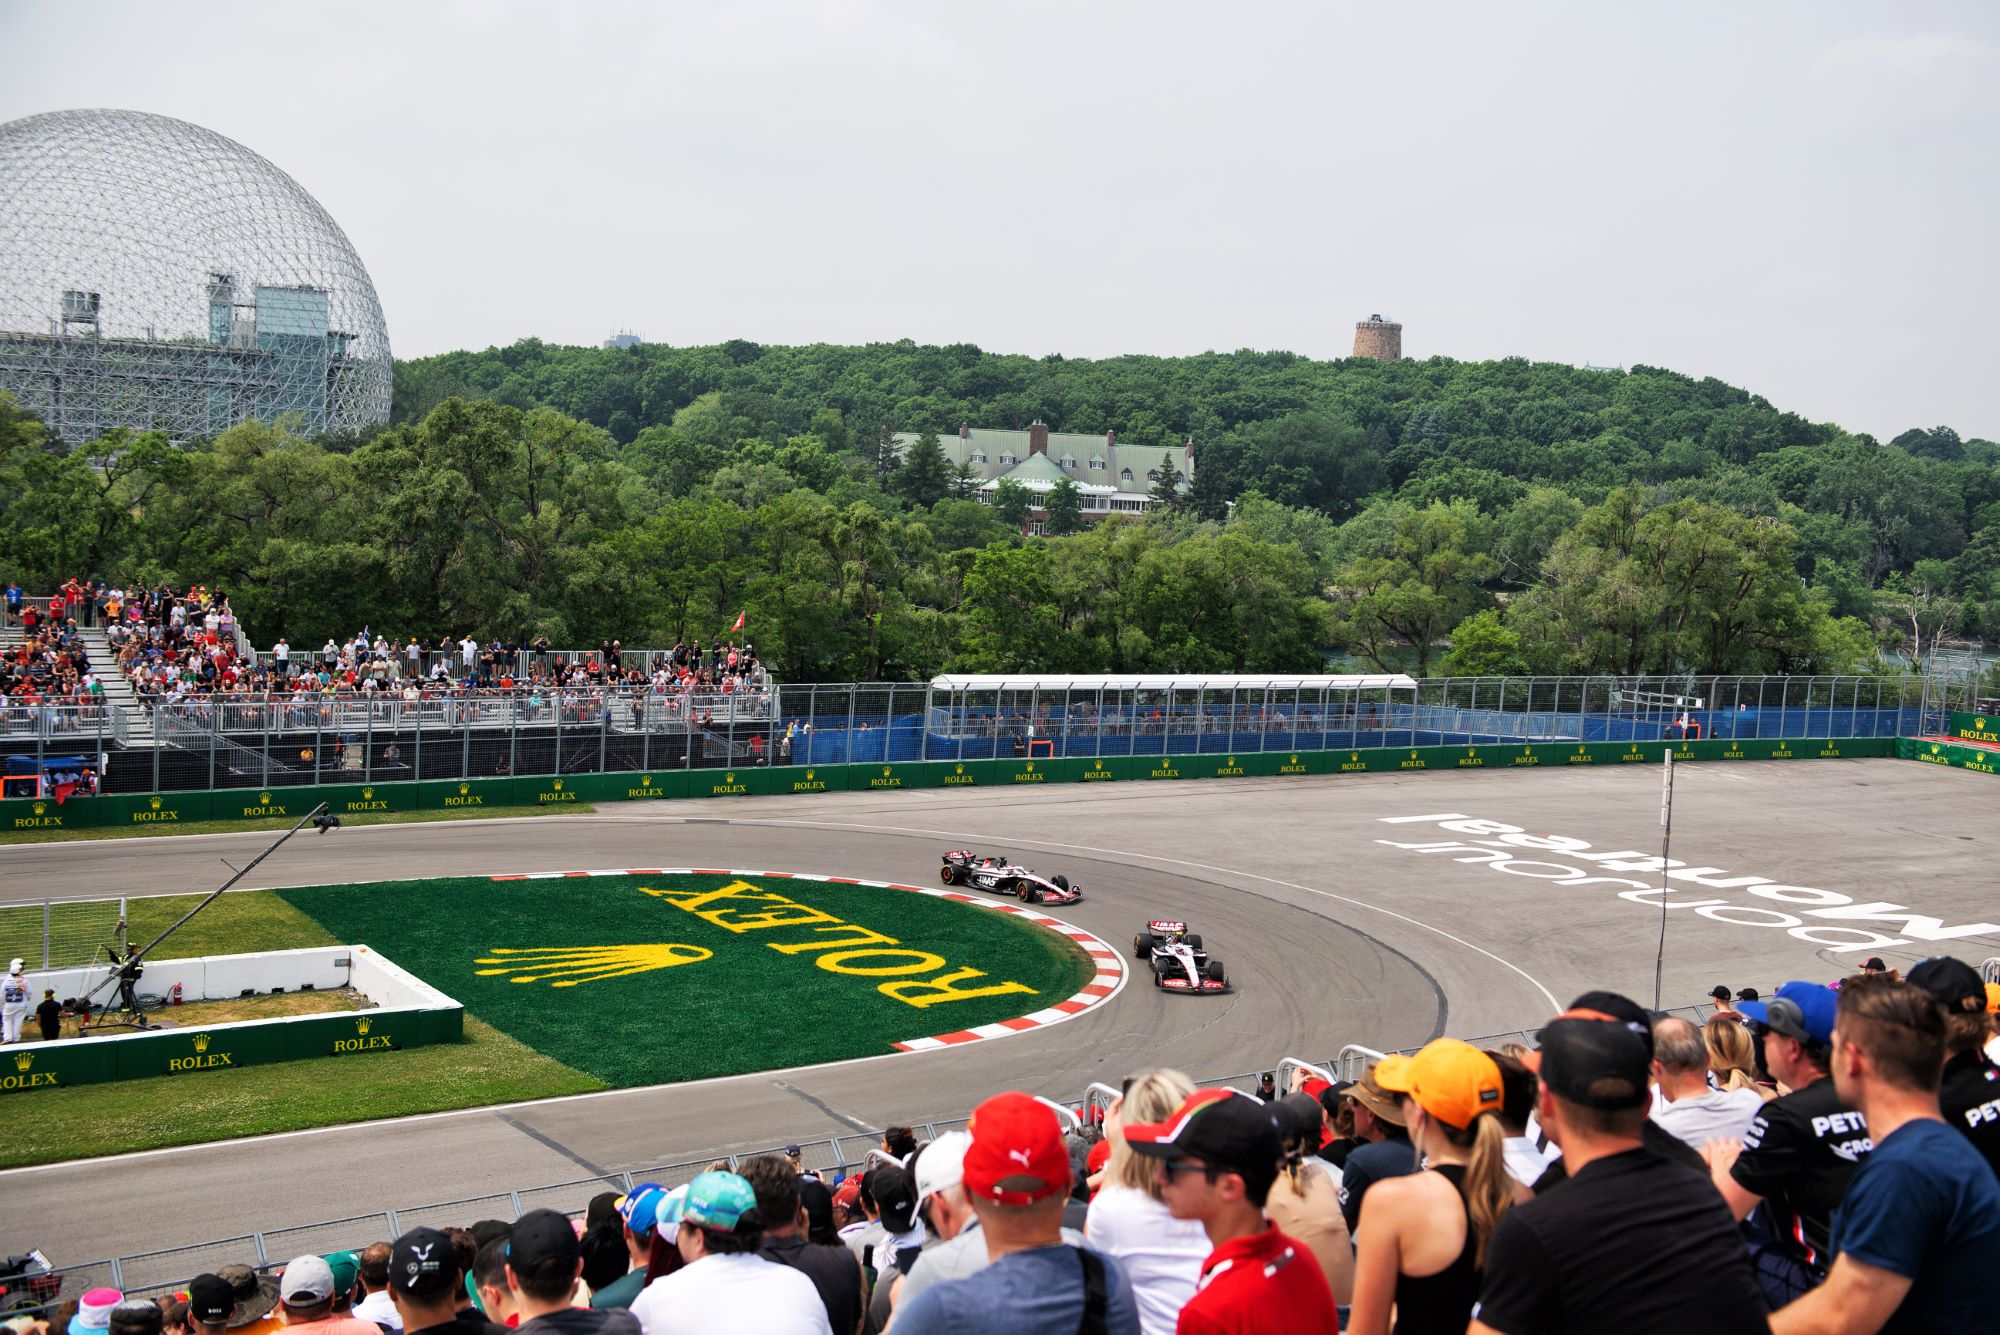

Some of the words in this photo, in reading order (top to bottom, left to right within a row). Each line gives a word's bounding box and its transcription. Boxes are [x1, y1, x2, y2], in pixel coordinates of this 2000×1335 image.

[1959, 729, 1999, 742] ROLEX
[1673, 752, 1695, 761] ROLEX
[1723, 752, 1744, 760] ROLEX
[1772, 751, 1792, 759] ROLEX
[1820, 749, 1840, 757] ROLEX
[1459, 758, 1483, 767] ROLEX
[1515, 756, 1538, 764] ROLEX
[1570, 755, 1592, 763] ROLEX
[1622, 754, 1644, 762] ROLEX
[1280, 764, 1306, 773] ROLEX
[1341, 762, 1367, 771] ROLEX
[1401, 760, 1425, 769] ROLEX
[1965, 761, 1994, 775] ROLEX
[1084, 771, 1112, 779] ROLEX
[1152, 769, 1179, 778] ROLEX
[1217, 767, 1244, 776] ROLEX
[944, 775, 973, 784] ROLEX
[1015, 773, 1044, 782] ROLEX
[794, 781, 825, 790] ROLEX
[871, 778, 901, 787] ROLEX
[628, 788, 663, 797] ROLEX
[713, 785, 747, 794] ROLEX
[444, 796, 482, 806] ROLEX
[539, 792, 576, 802] ROLEX
[347, 801, 388, 811] ROLEX
[243, 806, 286, 817] ROLEX
[133, 811, 178, 822] ROLEX
[15, 816, 63, 828] ROLEX
[638, 880, 1040, 1008] ROLEX
[334, 1035, 392, 1052] ROLEX
[169, 1053, 233, 1071] ROLEX
[0, 1072, 58, 1089] OLEX
